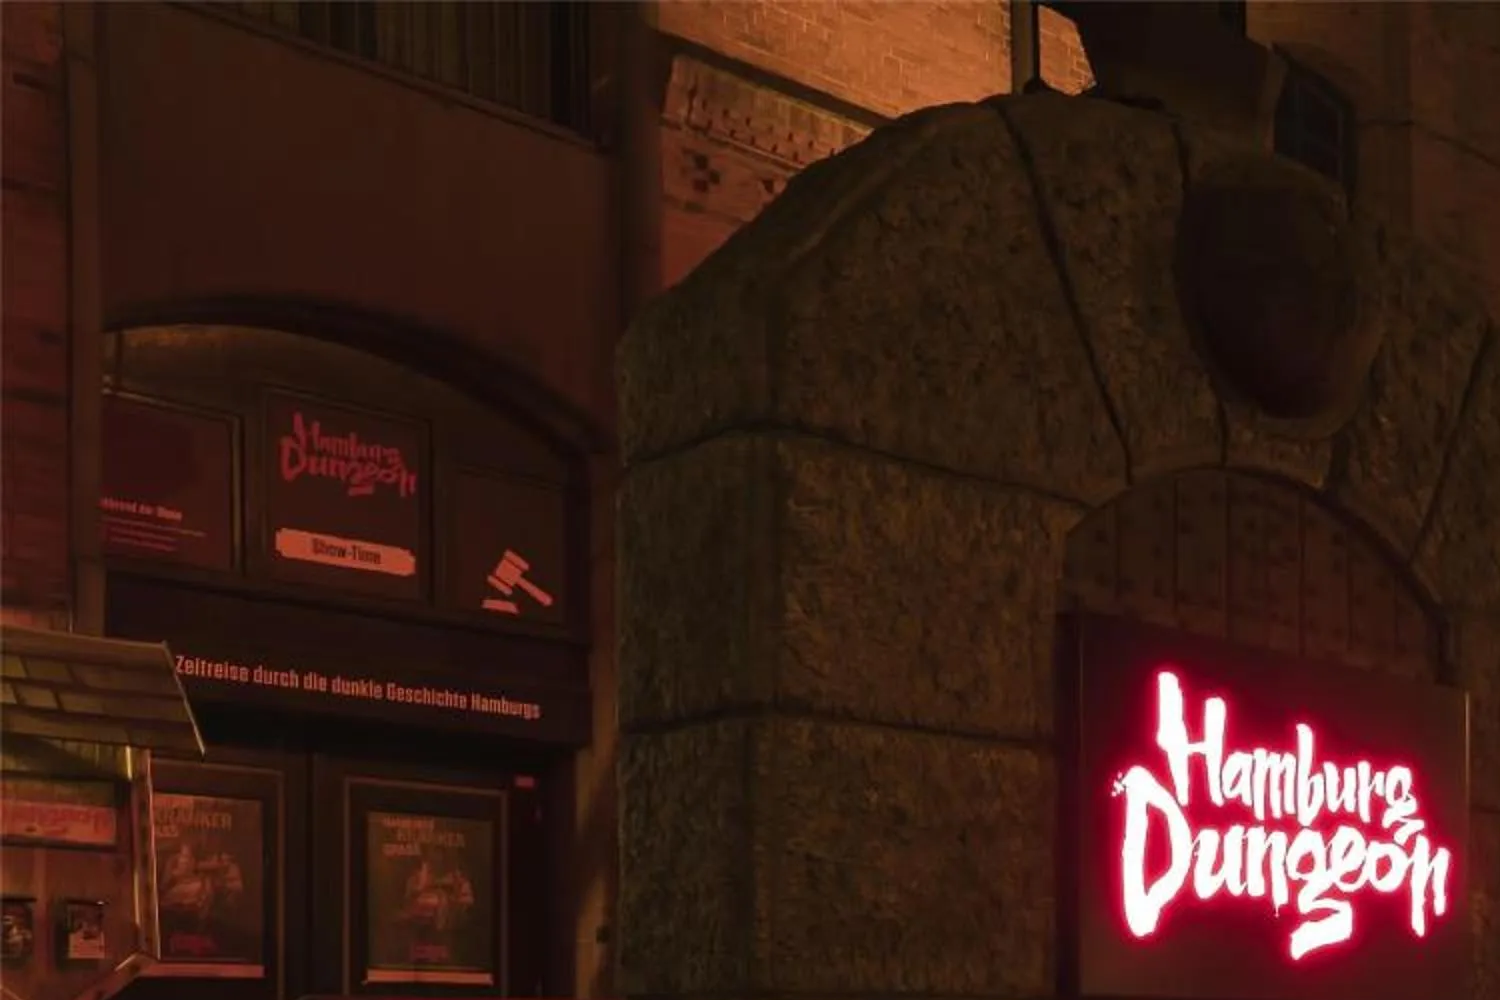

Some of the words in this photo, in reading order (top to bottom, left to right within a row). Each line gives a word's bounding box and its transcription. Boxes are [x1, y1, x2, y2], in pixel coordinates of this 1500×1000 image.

[280, 435, 417, 496] Dungeon
[175, 655, 250, 683] Zeitreise
[252, 664, 299, 689] durch
[303, 671, 328, 692] die
[331, 674, 383, 699] dunkle
[386, 681, 468, 710] Geschichte
[470, 692, 541, 720] Hamburgs
[1155, 671, 1426, 845] Hamburg
[1112, 765, 1452, 960] Dungeon
